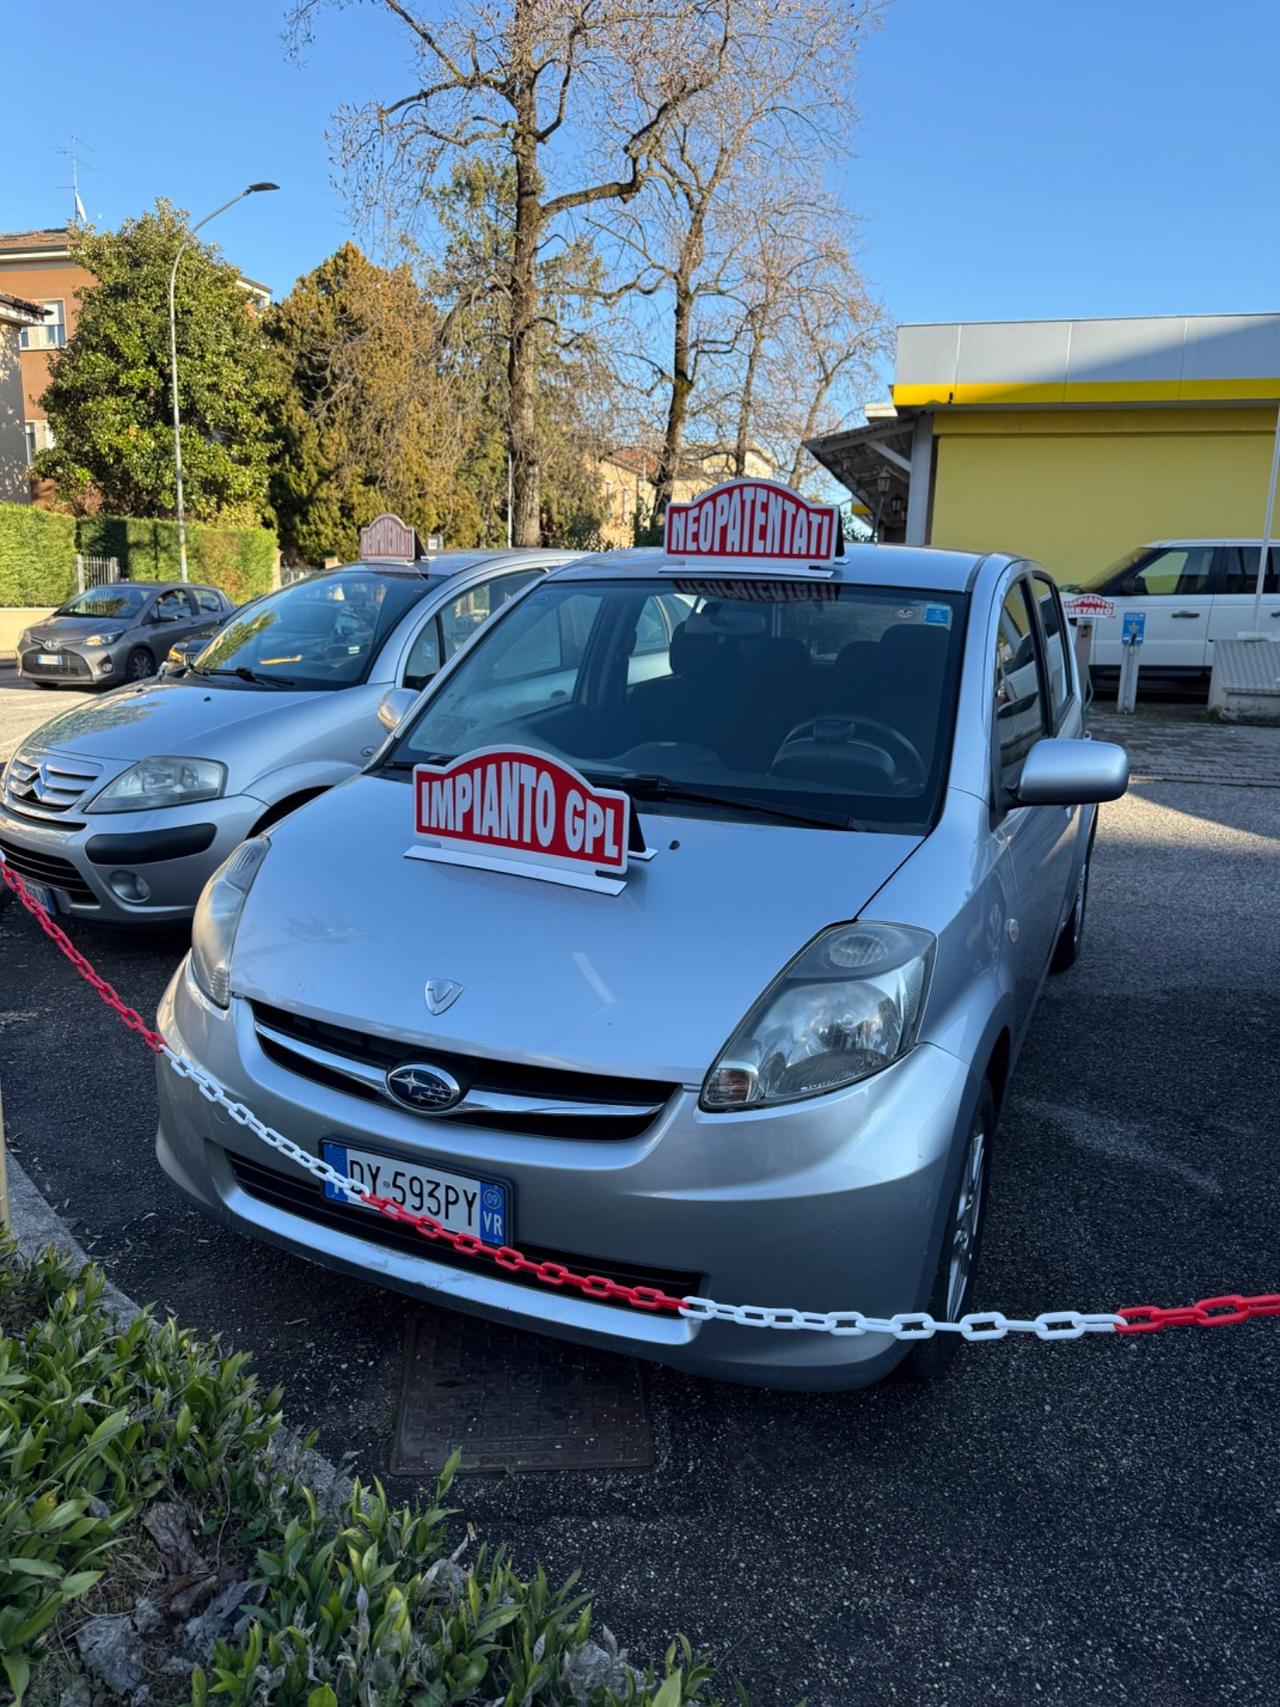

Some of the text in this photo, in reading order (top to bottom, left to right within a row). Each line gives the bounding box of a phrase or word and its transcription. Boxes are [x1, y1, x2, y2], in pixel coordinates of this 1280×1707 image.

[671, 486, 830, 556] NEOPATENTATI
[1064, 595, 1114, 608] IMPIANTO
[1065, 607, 1113, 616] METANO
[421, 761, 619, 859] IMPIANTO GPL
[482, 1210, 503, 1237] VR
